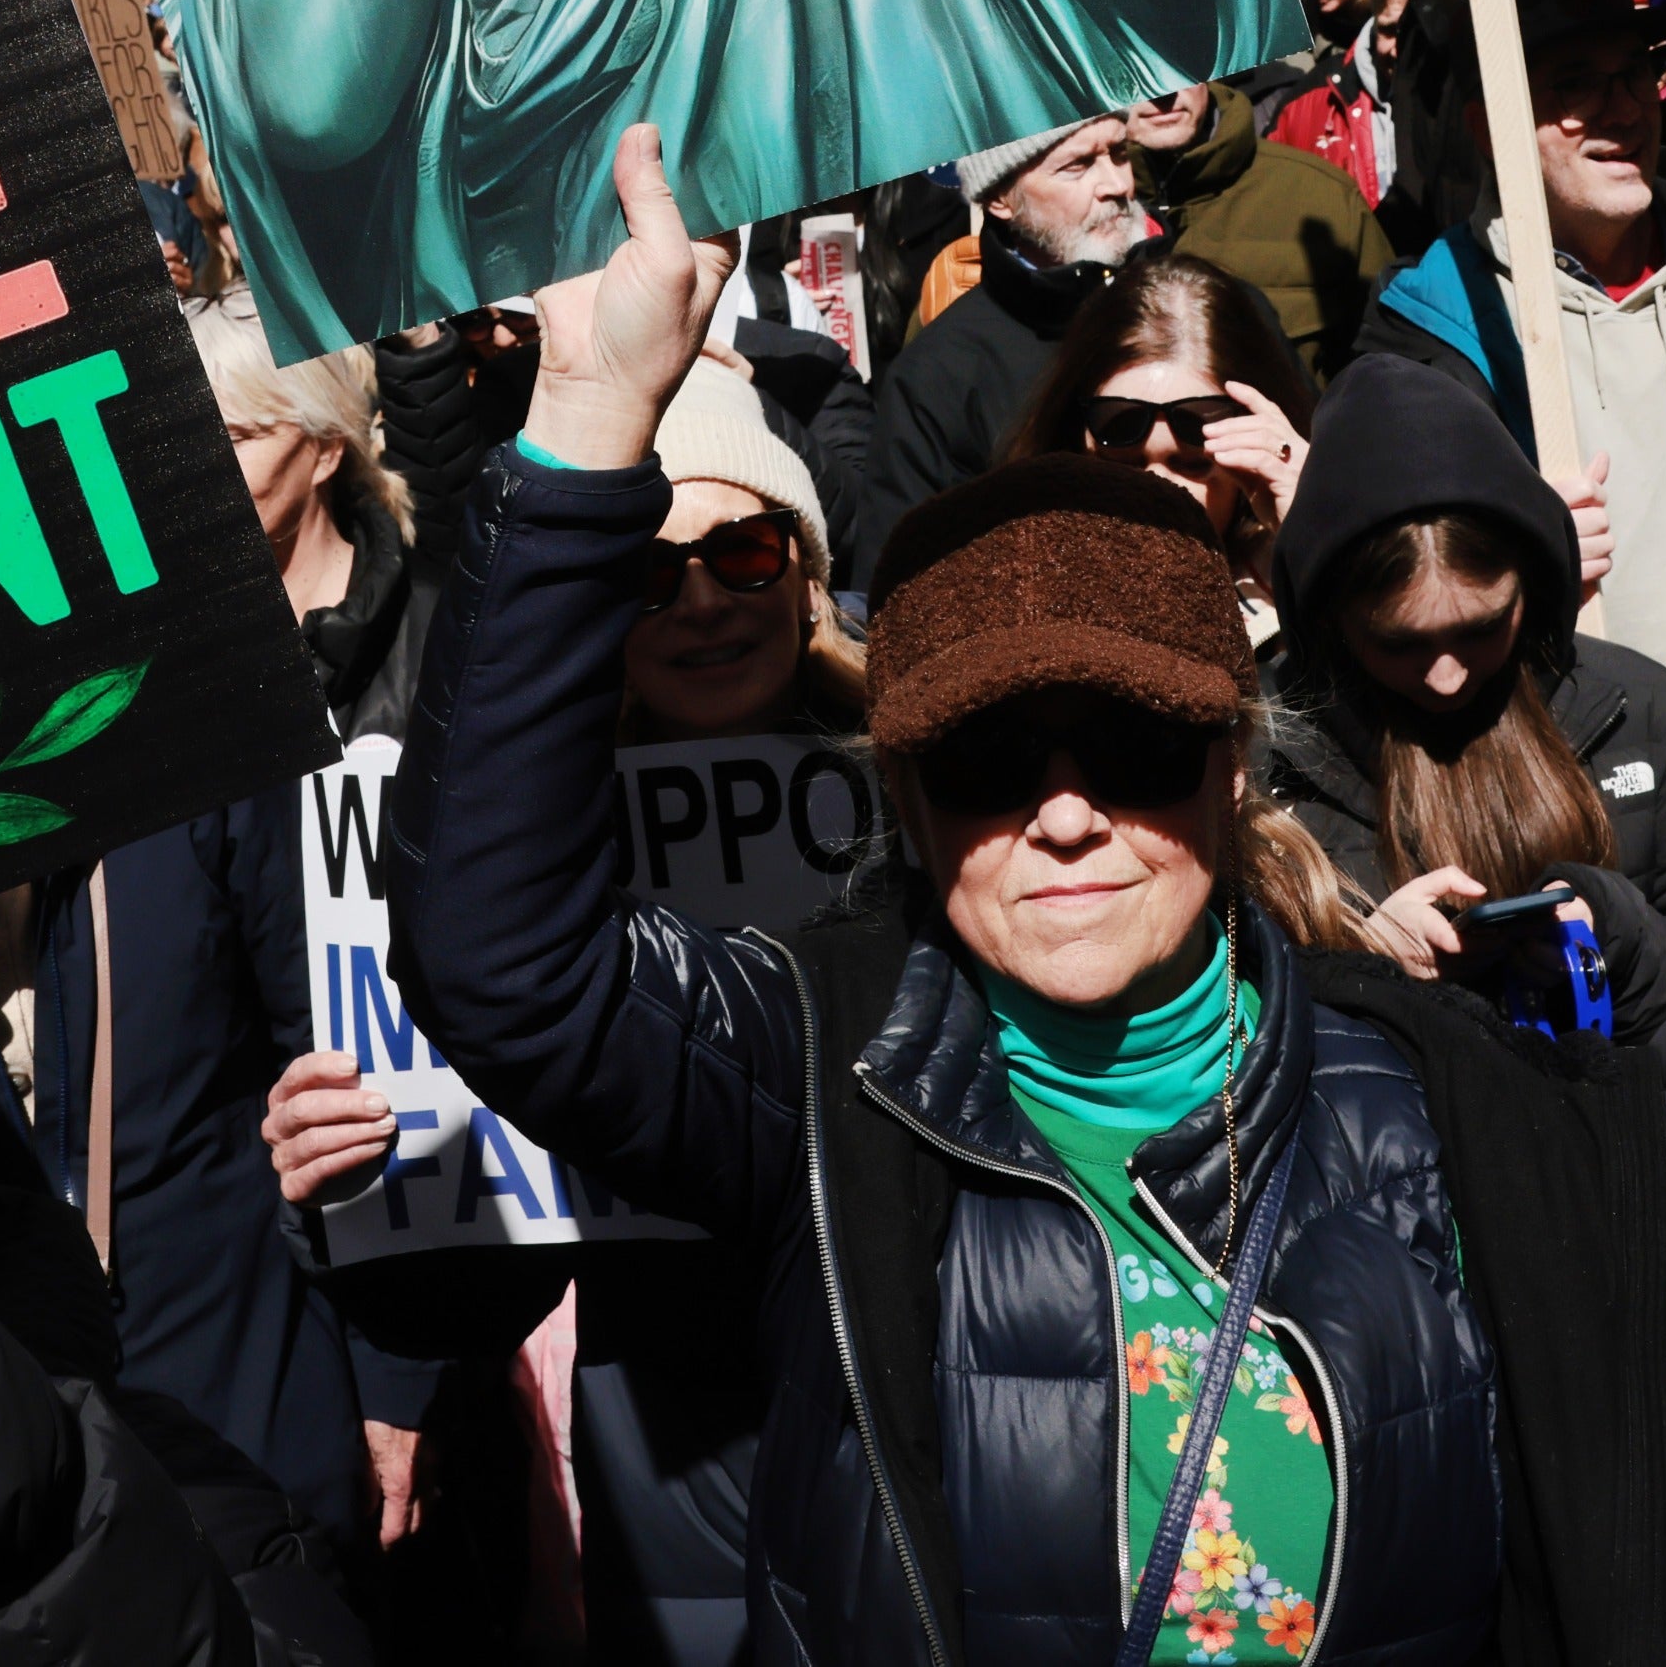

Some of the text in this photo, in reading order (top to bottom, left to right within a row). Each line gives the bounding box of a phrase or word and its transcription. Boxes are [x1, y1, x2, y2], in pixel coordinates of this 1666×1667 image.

[97, 42, 155, 98] FOR
[1613, 764, 1638, 777] THE
[1601, 773, 1640, 791] NORTH
[1614, 783, 1642, 799] FACE
[313, 772, 395, 900] W
